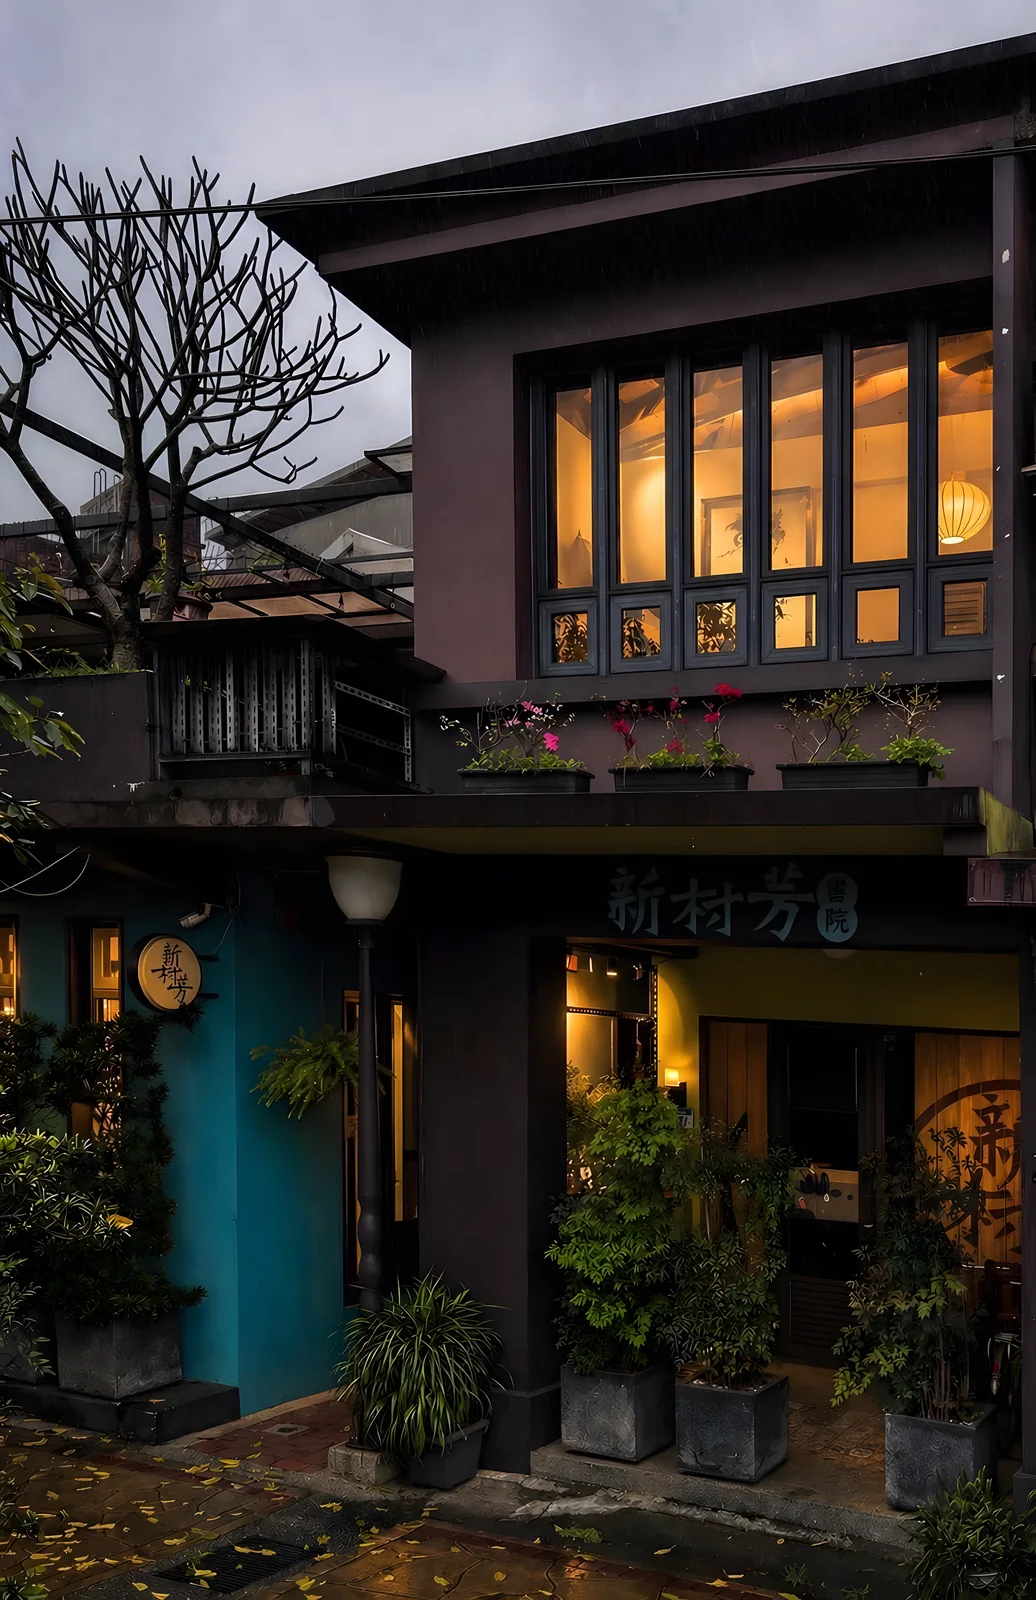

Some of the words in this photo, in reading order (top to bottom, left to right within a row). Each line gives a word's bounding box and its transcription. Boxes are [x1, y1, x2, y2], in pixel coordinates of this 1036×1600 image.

[607, 861, 816, 942] 新村芳
[826, 877, 850, 934] 書院
[151, 942, 193, 1003] 新村芳
